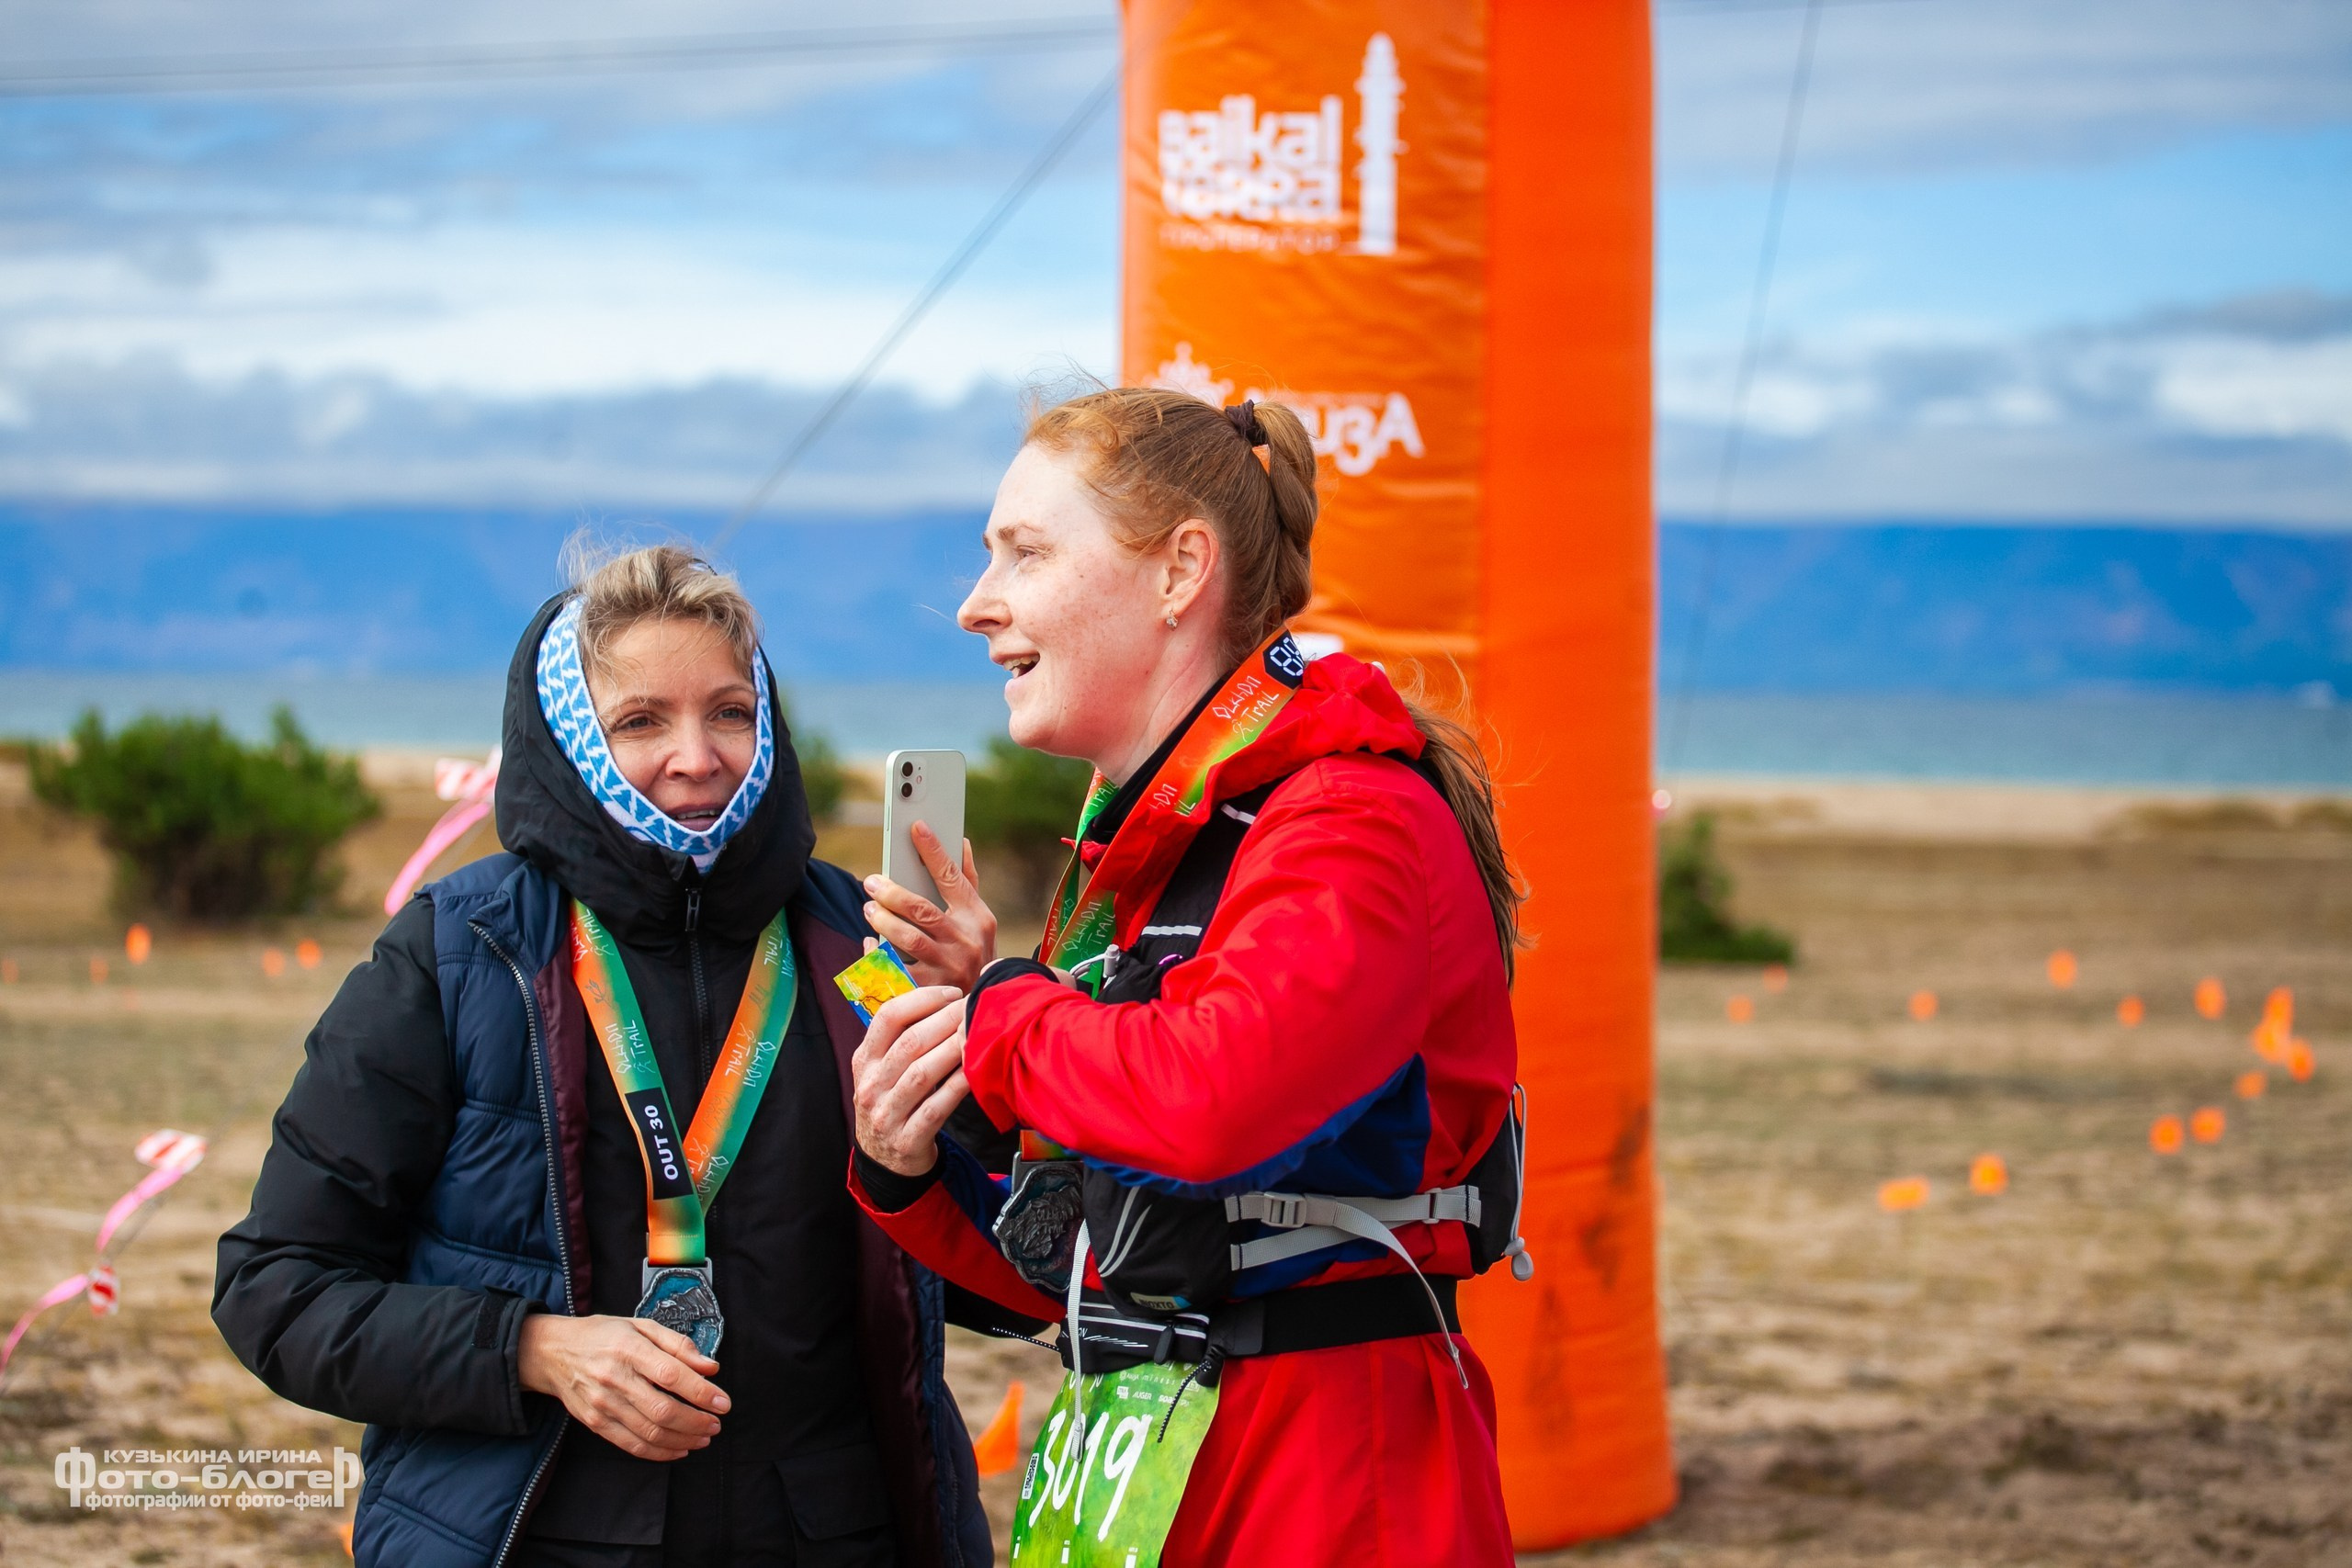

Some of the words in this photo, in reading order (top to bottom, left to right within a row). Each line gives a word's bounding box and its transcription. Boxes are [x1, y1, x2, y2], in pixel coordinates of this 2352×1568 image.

[644, 1104, 663, 1130] 30
[653, 1134, 679, 1180] OUT
[1029, 1409, 1153, 1542] 3019
